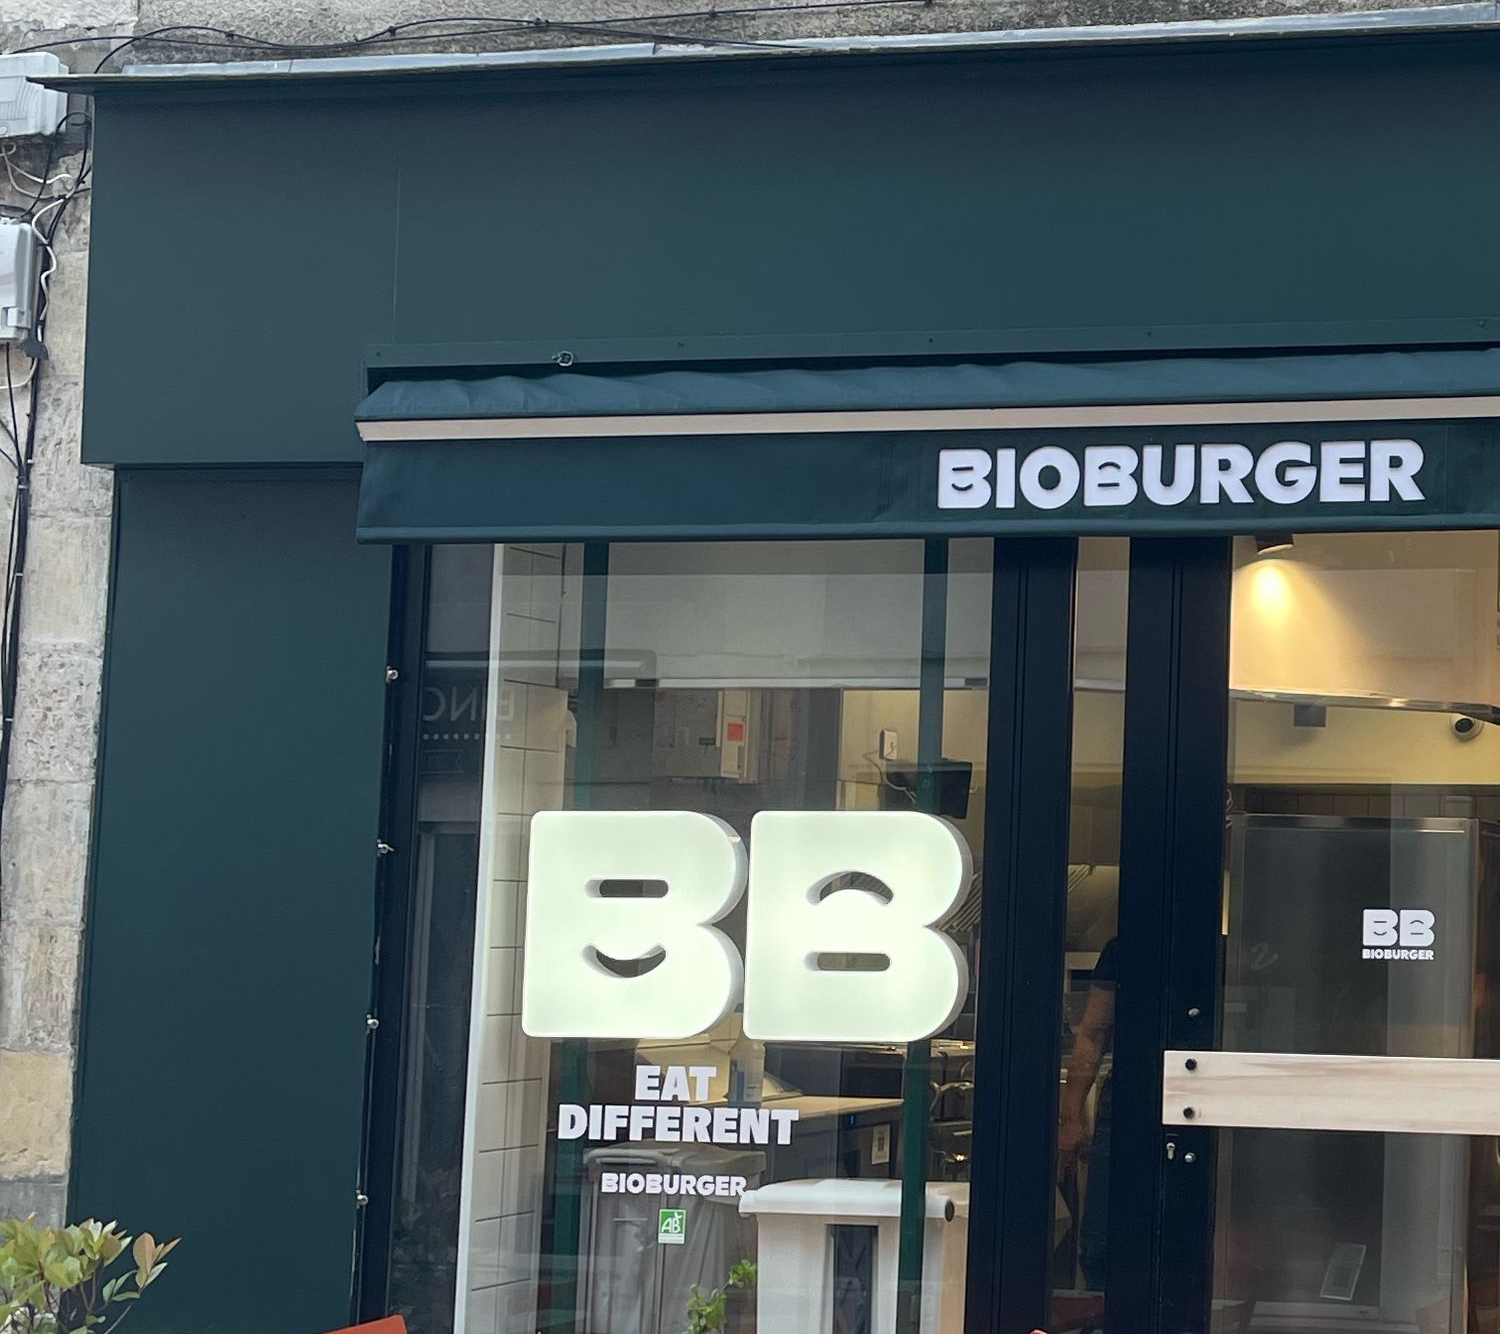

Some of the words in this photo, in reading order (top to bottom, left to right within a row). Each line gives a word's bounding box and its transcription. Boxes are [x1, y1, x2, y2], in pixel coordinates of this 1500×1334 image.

[937, 439, 1426, 510] BIOBURGER
[521, 810, 974, 1042] BB
[1362, 909, 1435, 947] BB
[1361, 948, 1435, 961] BIOBURGER
[634, 1064, 717, 1101] EAT
[557, 1104, 800, 1145] DIFFERENT
[600, 1172, 748, 1197] BIOBURGER
